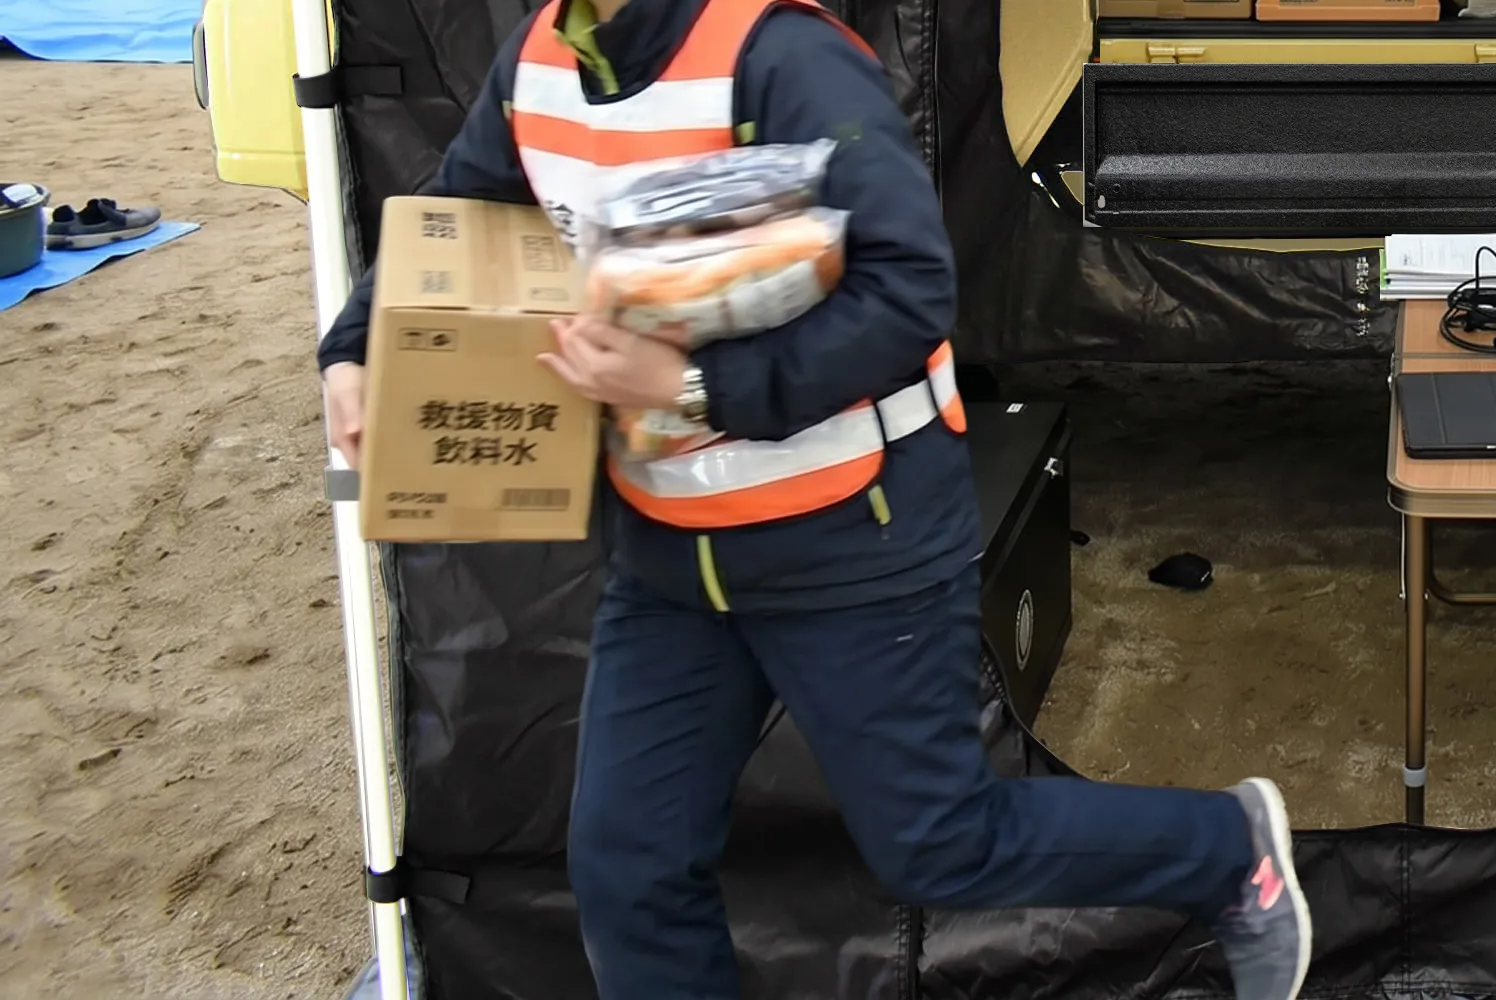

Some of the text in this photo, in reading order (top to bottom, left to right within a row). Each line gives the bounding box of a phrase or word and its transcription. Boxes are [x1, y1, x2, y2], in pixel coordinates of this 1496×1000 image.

[417, 400, 560, 432] 救援物資
[432, 435, 538, 466] 飲料水
